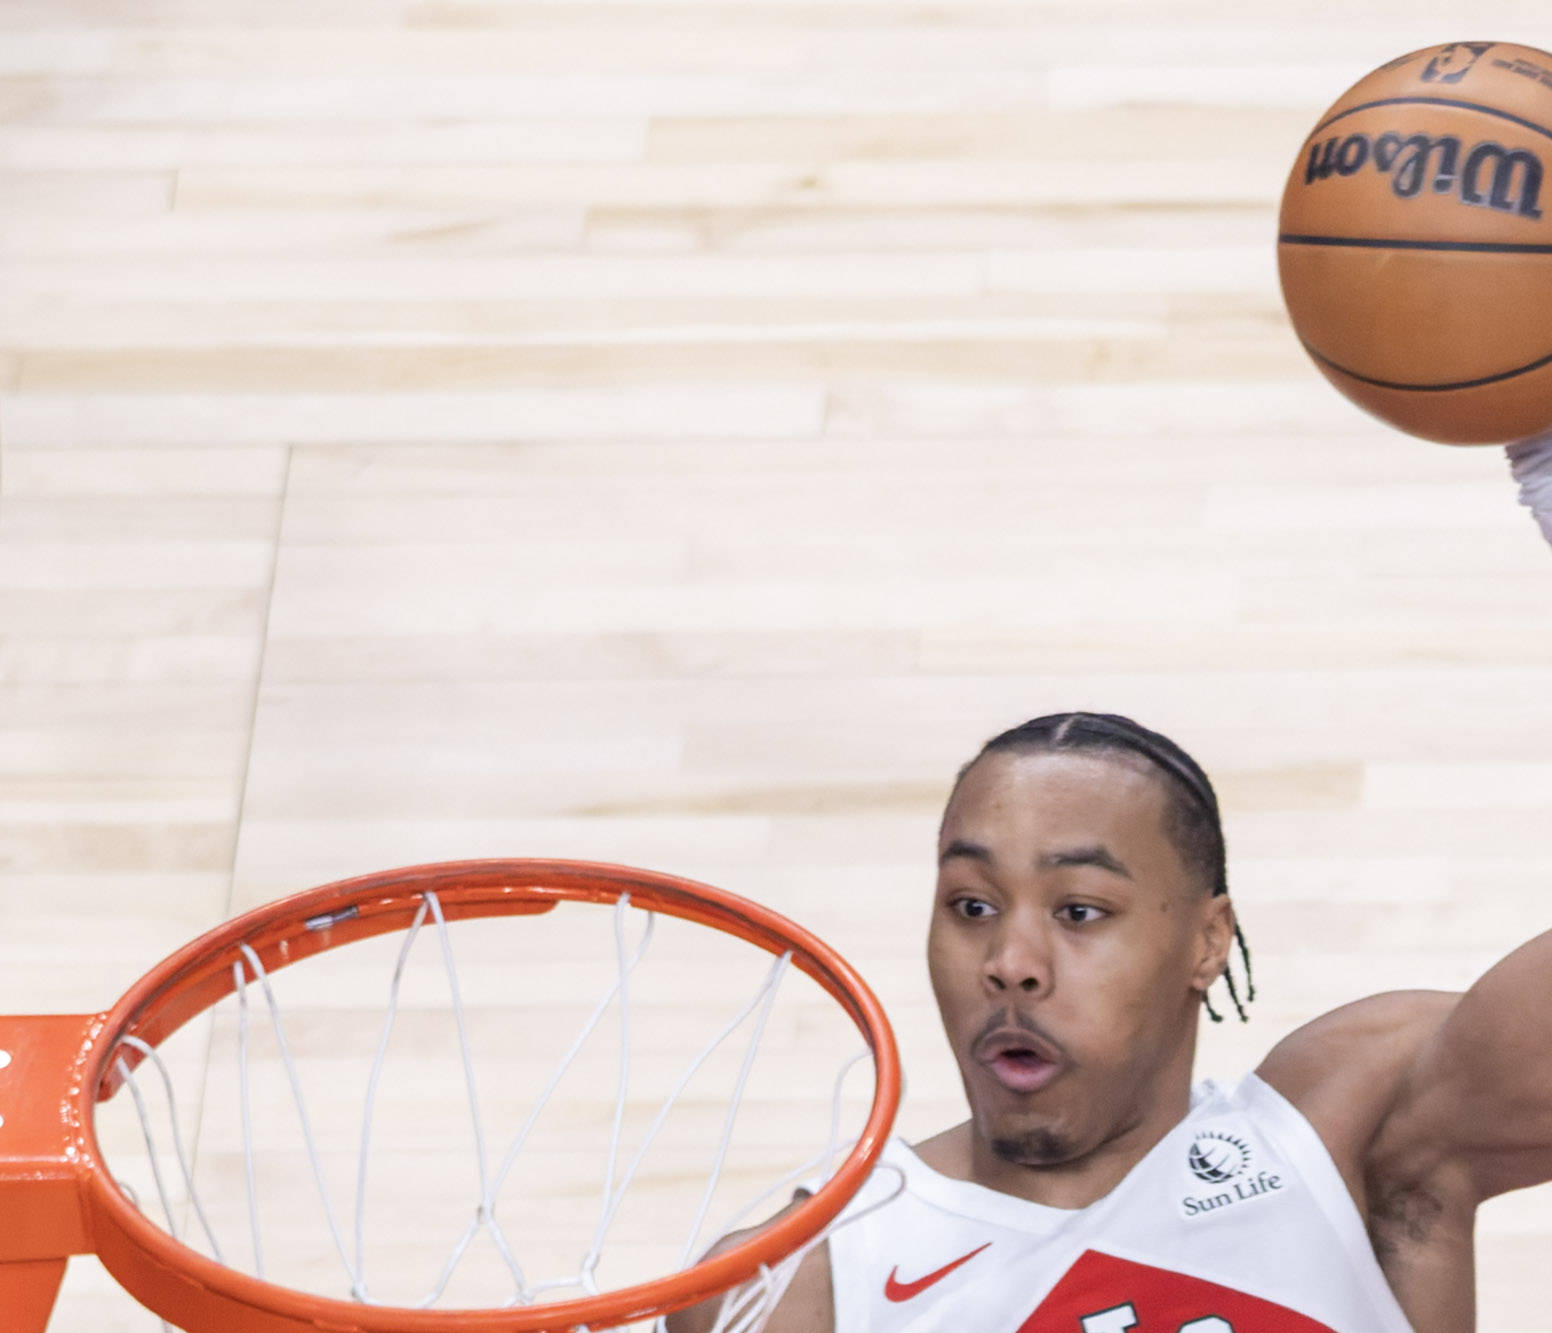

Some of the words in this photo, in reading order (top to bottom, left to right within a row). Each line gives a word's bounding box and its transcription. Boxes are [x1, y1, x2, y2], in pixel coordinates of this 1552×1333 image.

[1303, 130, 1545, 221] Wilson
[1182, 1192, 1233, 1217] Sun
[1233, 1171, 1284, 1201] Life
